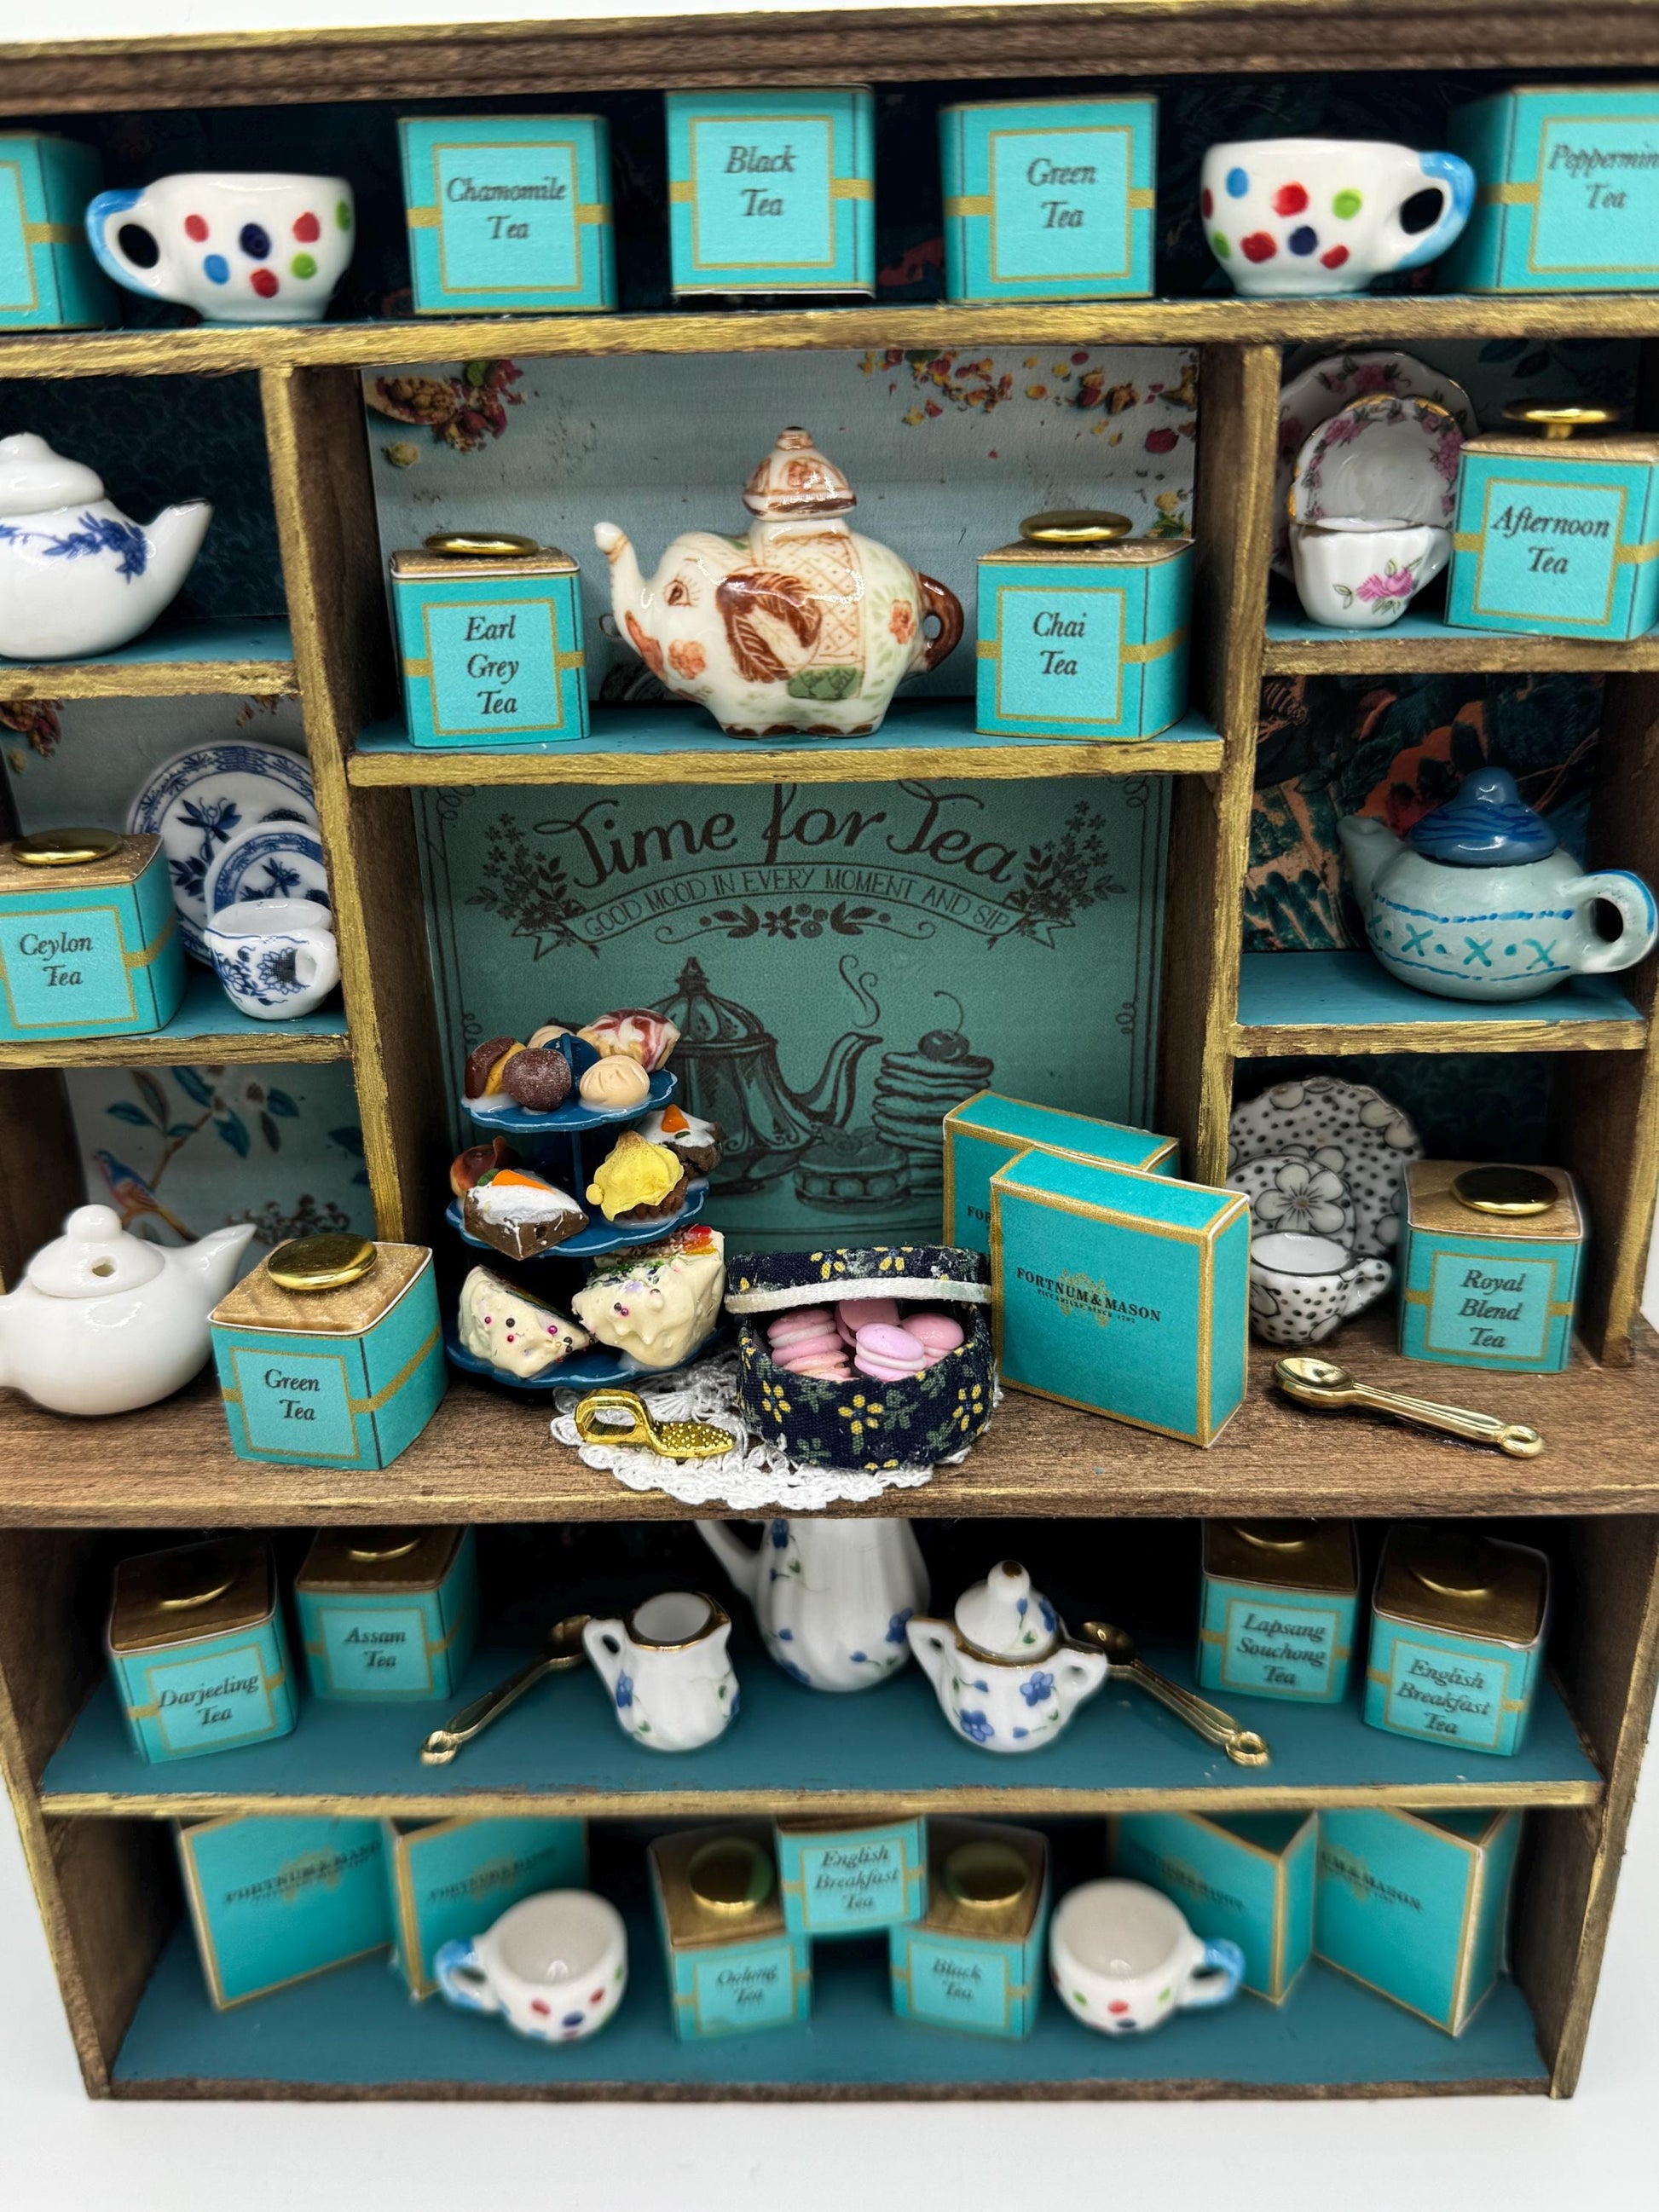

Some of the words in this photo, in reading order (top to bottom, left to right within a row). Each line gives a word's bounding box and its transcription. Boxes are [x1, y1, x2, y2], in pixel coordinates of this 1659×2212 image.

[724, 144, 797, 175] Black
[1026, 157, 1098, 188] Green
[446, 176, 568, 205] Chamomile
[740, 188, 785, 218] Tea
[1586, 182, 1629, 210] Tea
[486, 215, 530, 241] Tea
[1040, 200, 1085, 230] Tea
[1490, 505, 1611, 540] Afternoon
[1527, 546, 1569, 575] Tea
[463, 614, 517, 643] Earl
[1032, 611, 1088, 639] Chai
[466, 653, 520, 685] Grey
[1038, 650, 1078, 677] Tea
[477, 689, 519, 716] Tea
[533, 799, 738, 888] Time
[761, 783, 887, 864] for
[885, 780, 1018, 883] Tea
[585, 900, 643, 936] GOOD
[644, 879, 707, 912] MOOD
[711, 874, 736, 895] IN
[741, 868, 814, 892] EVERY
[825, 868, 918, 899] MOMENT
[922, 885, 972, 916] AND
[973, 904, 1010, 931] SIP
[19, 932, 94, 962] Ceylon
[42, 964, 84, 988] Tea
[1016, 1267, 1089, 1302] FORTNUM
[1091, 1293, 1102, 1307] &
[1104, 1297, 1162, 1322] MASON
[1459, 1268, 1527, 1297] Royal
[1456, 1297, 1524, 1322] Blend
[1468, 1326, 1507, 1349] Tea
[263, 1368, 322, 1393] Green
[279, 1399, 318, 1422] Tea
[344, 1626, 408, 1645] Assam
[1242, 1613, 1327, 1643] Lapsang
[363, 1649, 397, 1670] Tea
[1236, 1637, 1327, 1668] Souchong
[1262, 1664, 1297, 1687] Tea
[1408, 1658, 1484, 1689] English
[158, 1674, 259, 1710] Darjeeling
[1396, 1680, 1492, 1717] Breakfast
[196, 1707, 234, 1727] Tea
[1424, 1712, 1459, 1736] Tea
[821, 1844, 890, 1868] English
[815, 1868, 899, 1890] Breakfast
[841, 1893, 875, 1909] Tea
[733, 1987, 765, 2004] Tea
[942, 1979, 974, 2000] Tea
